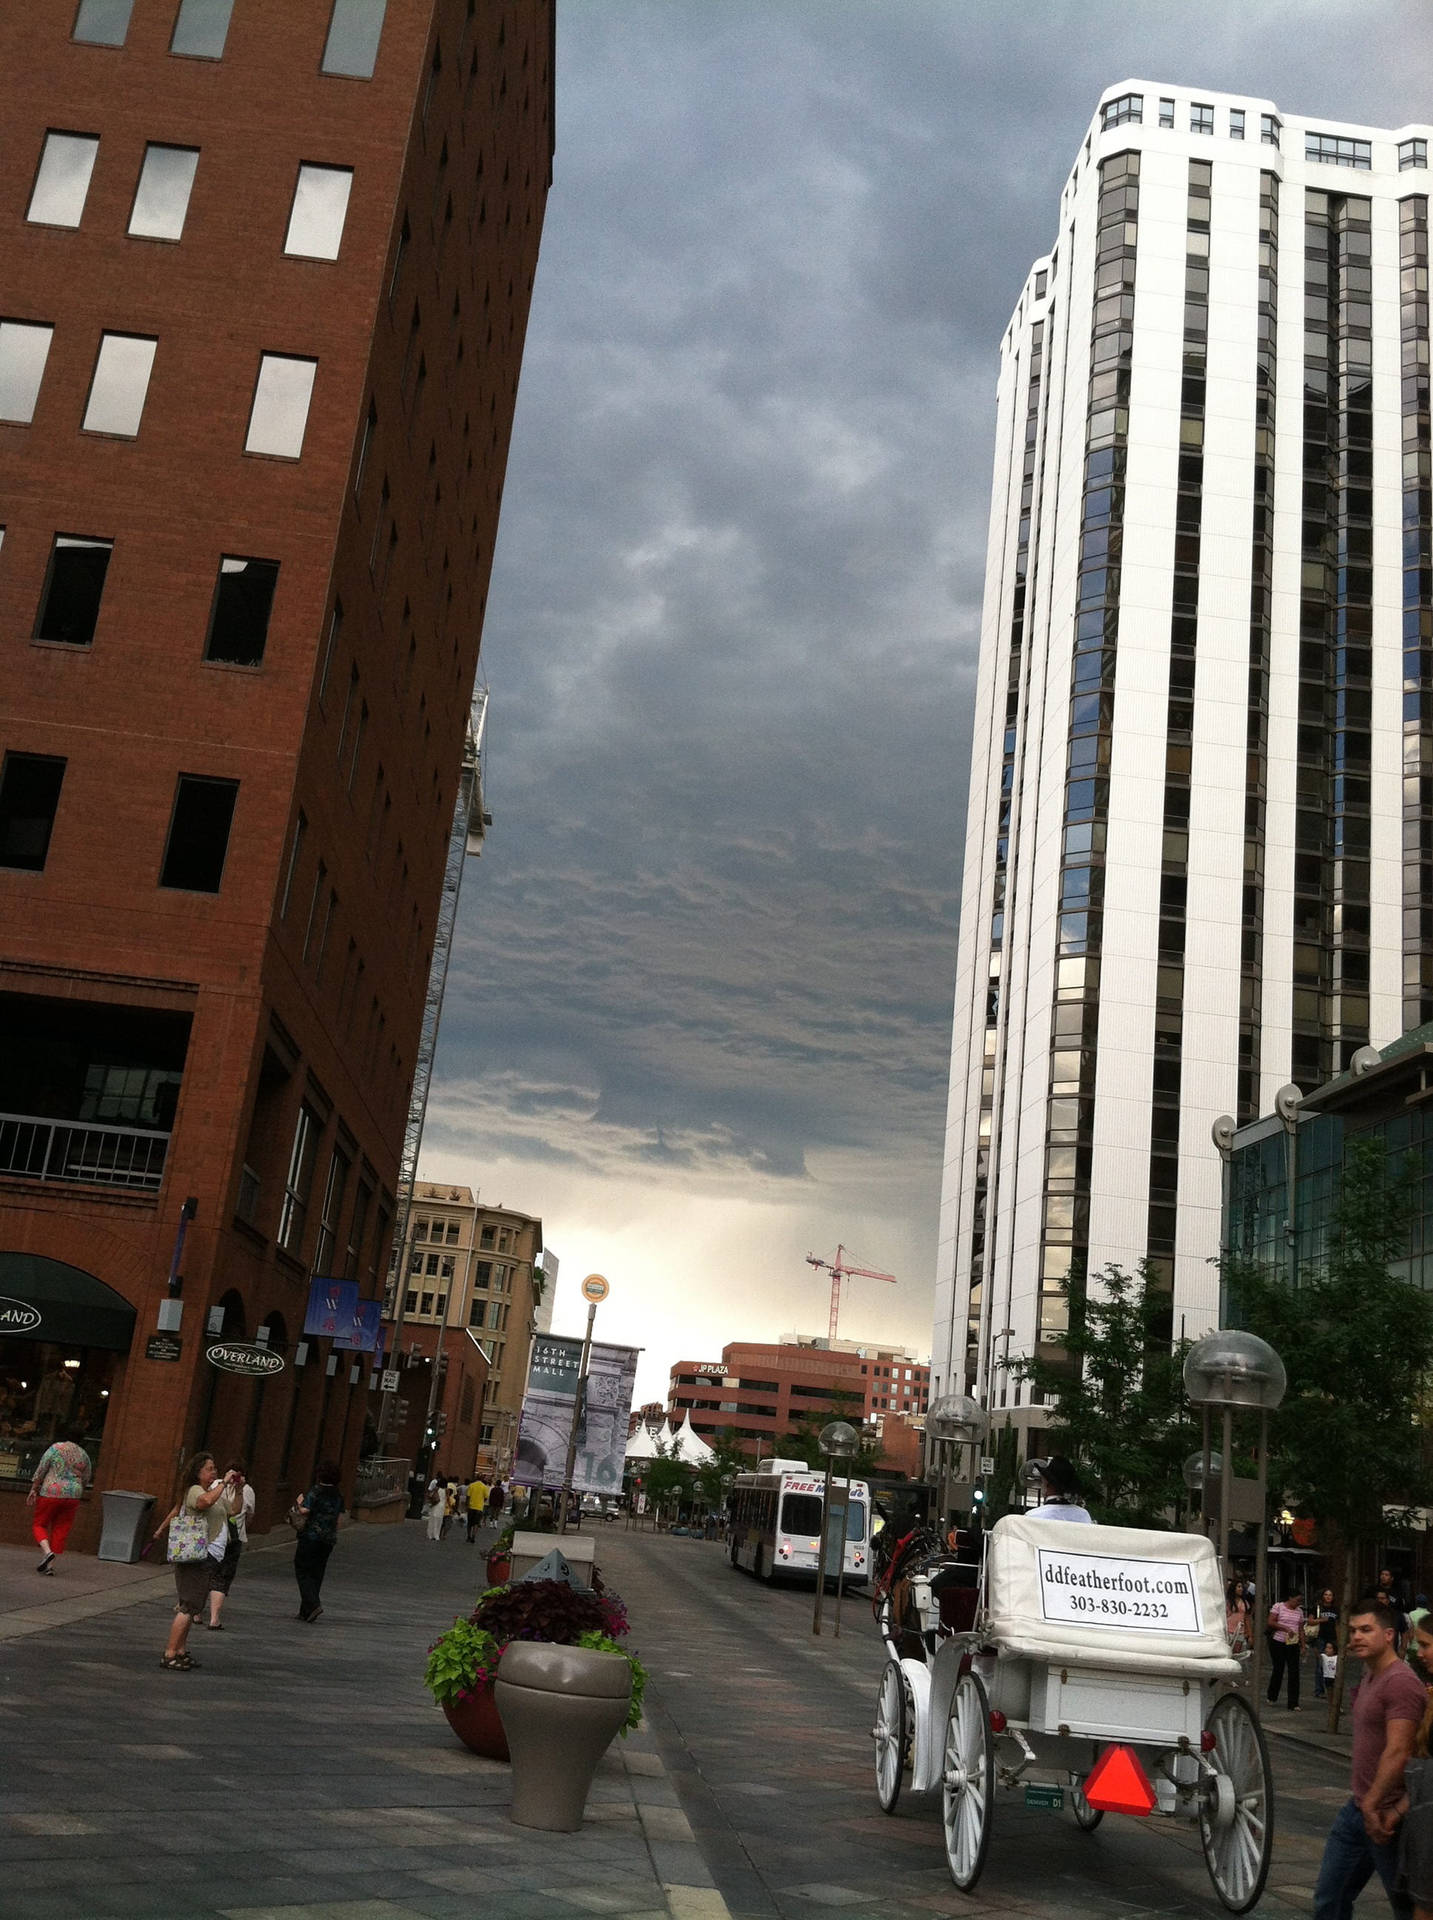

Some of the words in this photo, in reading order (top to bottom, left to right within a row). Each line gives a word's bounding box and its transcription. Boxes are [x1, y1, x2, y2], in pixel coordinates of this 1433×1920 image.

[536, 1345, 566, 1357] 16TH
[211, 1347, 280, 1369] OVERLAND
[534, 1355, 579, 1369] STREET
[385, 1371, 396, 1379] ONE
[533, 1366, 564, 1377] MALL
[707, 1365, 729, 1375] PLAZA
[582, 1450, 617, 1487] 16
[784, 1481, 815, 1492] FREE
[1045, 1564, 1189, 1595] ddfeatherfoot.com
[1069, 1595, 1168, 1618] 303-830-2232
